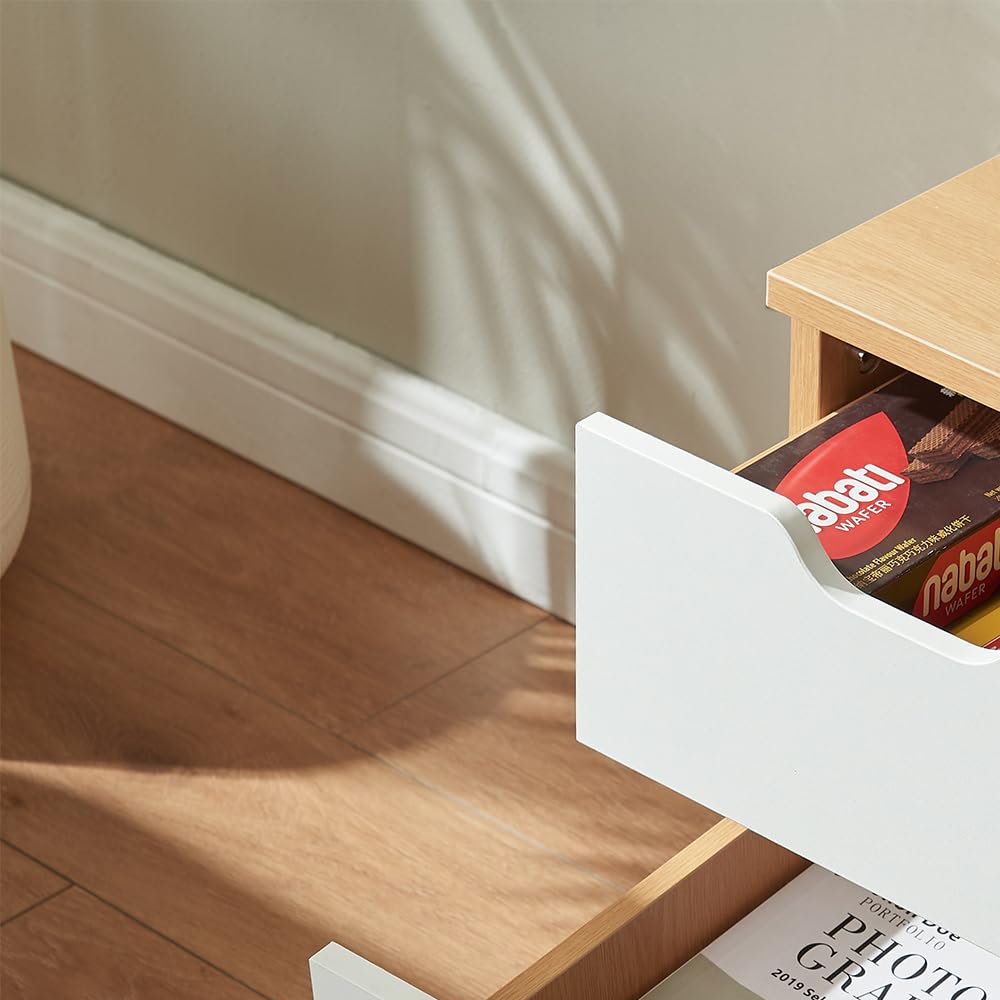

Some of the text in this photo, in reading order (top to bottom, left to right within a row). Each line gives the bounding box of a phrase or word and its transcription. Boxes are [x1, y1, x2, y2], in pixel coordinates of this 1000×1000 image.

[797, 464, 905, 534] abati
[835, 499, 892, 532] WAFER
[894, 537, 917, 554] Wafer
[945, 582, 986, 616] WAFER
[859, 896, 946, 951] PORTFOLIO
[771, 968, 805, 991] 2019
